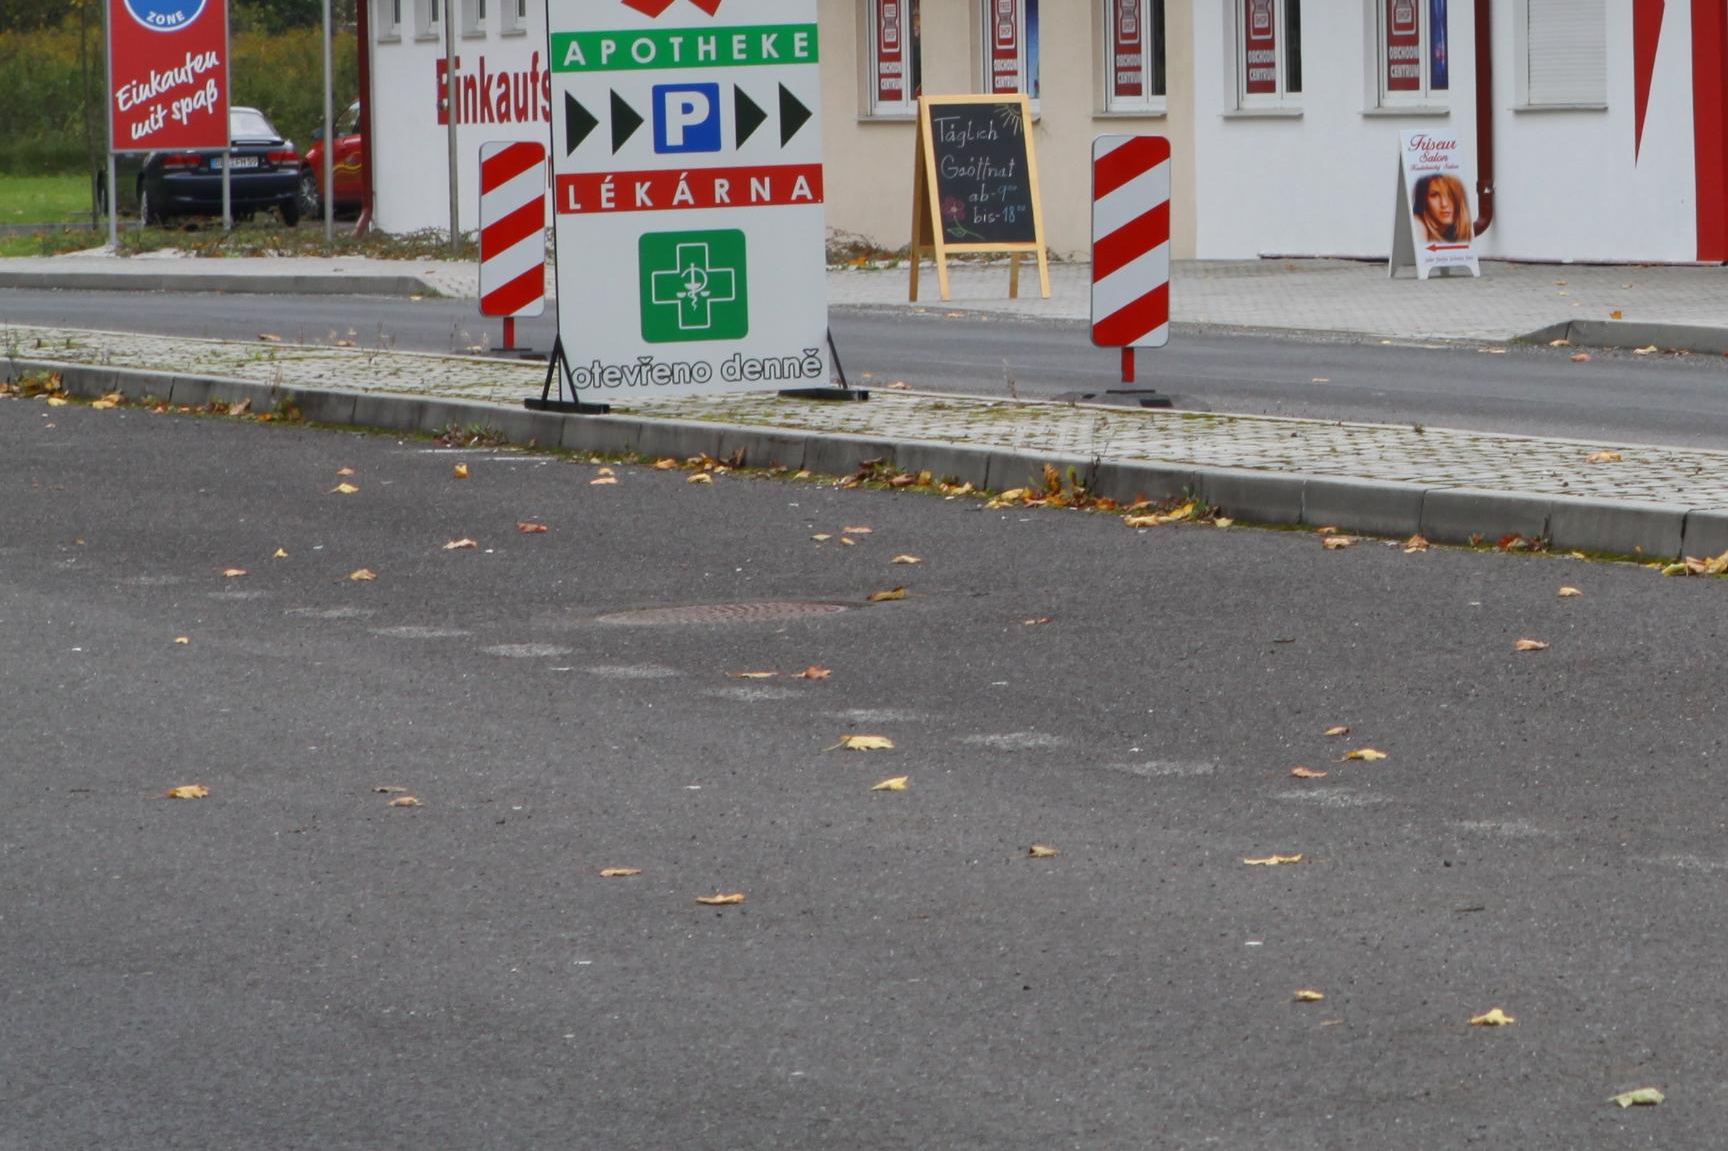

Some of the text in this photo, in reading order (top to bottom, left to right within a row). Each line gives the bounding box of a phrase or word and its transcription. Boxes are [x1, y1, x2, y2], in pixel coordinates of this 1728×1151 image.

[146, 11, 186, 25] ZONE
[563, 32, 809, 67] APOTHEKE
[115, 51, 220, 112] Einkaufen
[131, 79, 218, 140] mit spaß
[664, 91, 710, 146] P
[1408, 134, 1456, 151] Friseur
[1419, 152, 1449, 162] Salon
[567, 171, 814, 210] LÉKÁRNA
[571, 348, 822, 389] otevřeno denně
